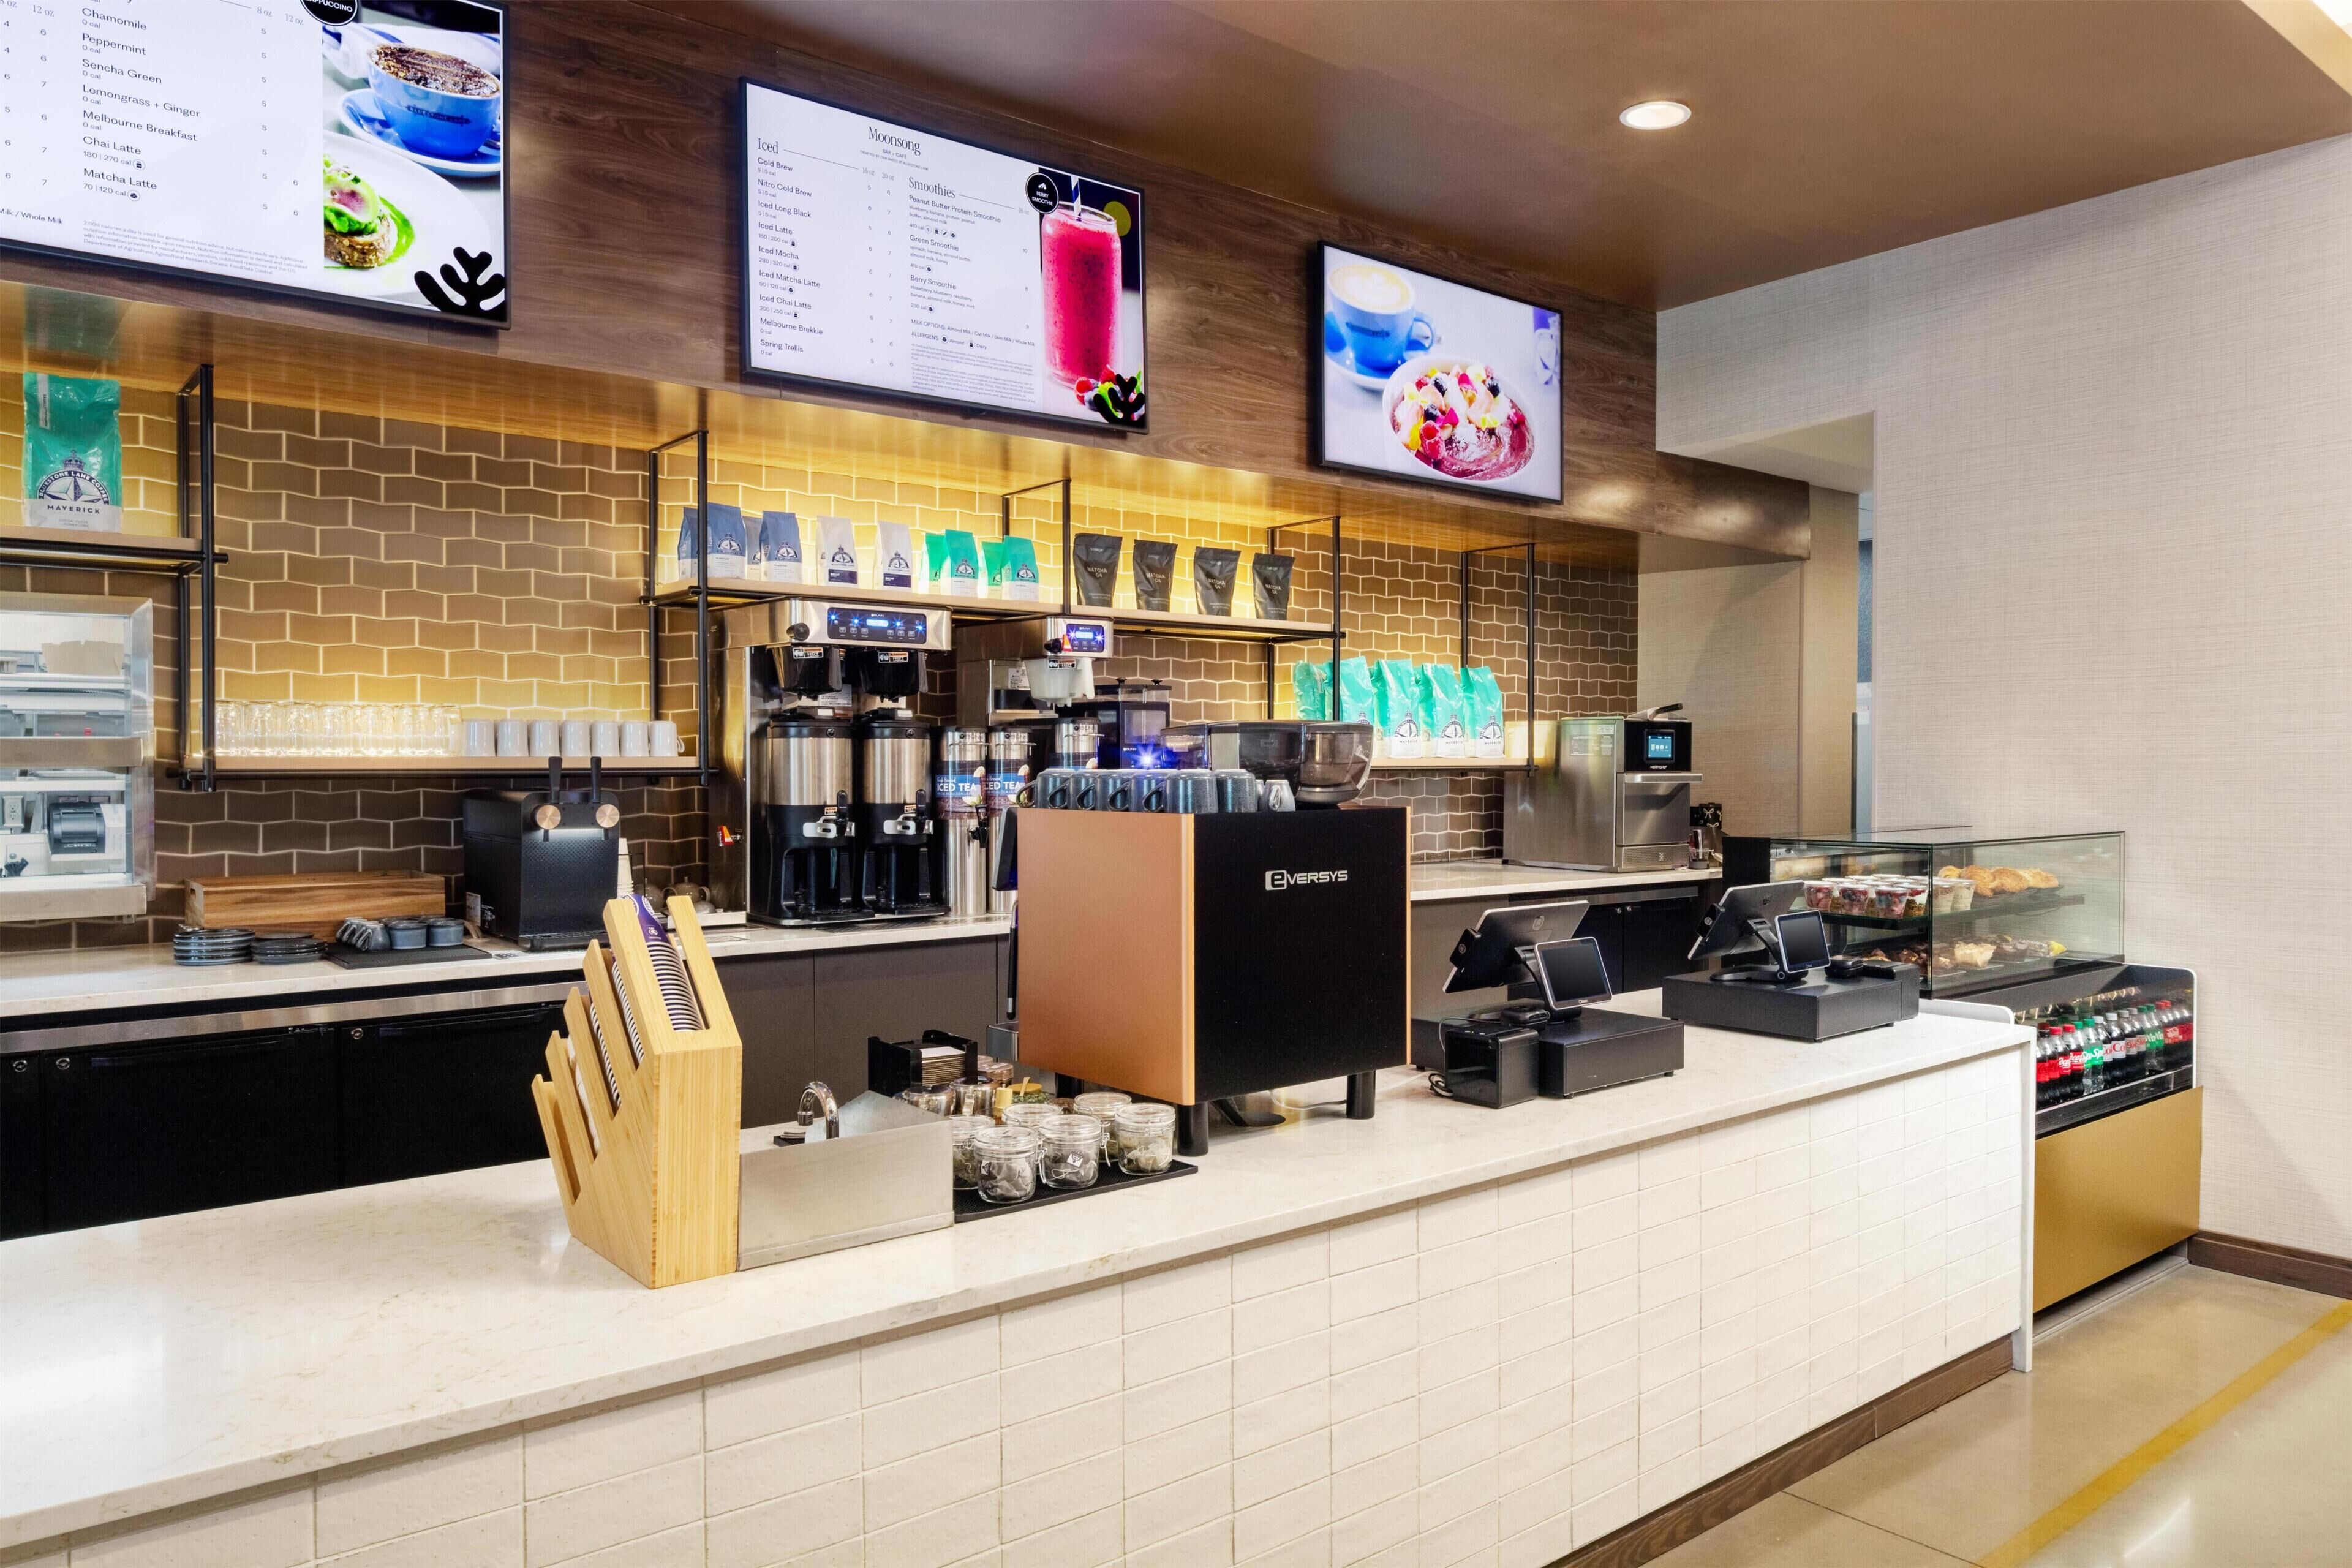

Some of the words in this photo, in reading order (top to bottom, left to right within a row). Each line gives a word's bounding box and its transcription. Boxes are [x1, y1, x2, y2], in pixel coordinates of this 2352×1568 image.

[33, 4, 42, 14] 12
[308, 0, 352, 12] PUCCINO
[82, 8, 146, 30] Chamomile
[285, 13, 293, 23] 12
[83, 33, 146, 55] Peppermint
[83, 59, 124, 75] Sencha
[127, 69, 162, 84] Green
[83, 84, 150, 106] Lemongrass
[163, 103, 200, 117] Ginger
[83, 110, 143, 130] Melbourne
[146, 124, 197, 141] Breakfast
[83, 136, 109, 148] Chai
[113, 142, 141, 154] Latte
[758, 138, 778, 154] Iced
[869, 127, 921, 156] Moonsong
[758, 157, 774, 167] Cold
[776, 162, 793, 172] Brew
[84, 168, 126, 184] Matcha
[130, 177, 157, 189] Latte
[758, 178, 775, 189] Nitro
[777, 183, 793, 193] Cold
[795, 187, 812, 197] Brew
[909, 177, 956, 198] Smoothies
[758, 200, 773, 209] Iced
[775, 204, 791, 215] Long
[793, 208, 811, 217] Black
[909, 195, 930, 206] Peanut
[932, 200, 950, 210] Butter
[951, 205, 972, 216] Protein
[973, 211, 1001, 223] Smoothie
[1031, 197, 1054, 206] SMOOTHIE
[21, 212, 45, 221] Whole
[758, 222, 773, 230] Iced
[775, 225, 793, 235] Latte
[910, 235, 929, 244] Green
[930, 239, 959, 251] Smoothie
[759, 246, 774, 254] Iced
[775, 249, 799, 260] Mocha
[760, 270, 774, 279] Iced
[776, 273, 802, 284] Matcha
[804, 279, 821, 288] Latte
[911, 274, 927, 285] Berry
[928, 278, 956, 290] Smoothie
[760, 294, 774, 303] Iced
[776, 297, 793, 306] Chai
[794, 300, 812, 309] Latte
[760, 318, 797, 330] Melbourne
[799, 325, 823, 335] Brekkie
[760, 339, 783, 350] Spring
[784, 343, 804, 352] Trellis
[39, 471, 69, 497] BLUESTONE
[71, 471, 91, 481] LANE
[91, 479, 108, 502] COFFEE
[47, 504, 100, 514] MAVERICK
[958, 783, 977, 791] TEA
[1003, 782, 1022, 790] TEA
